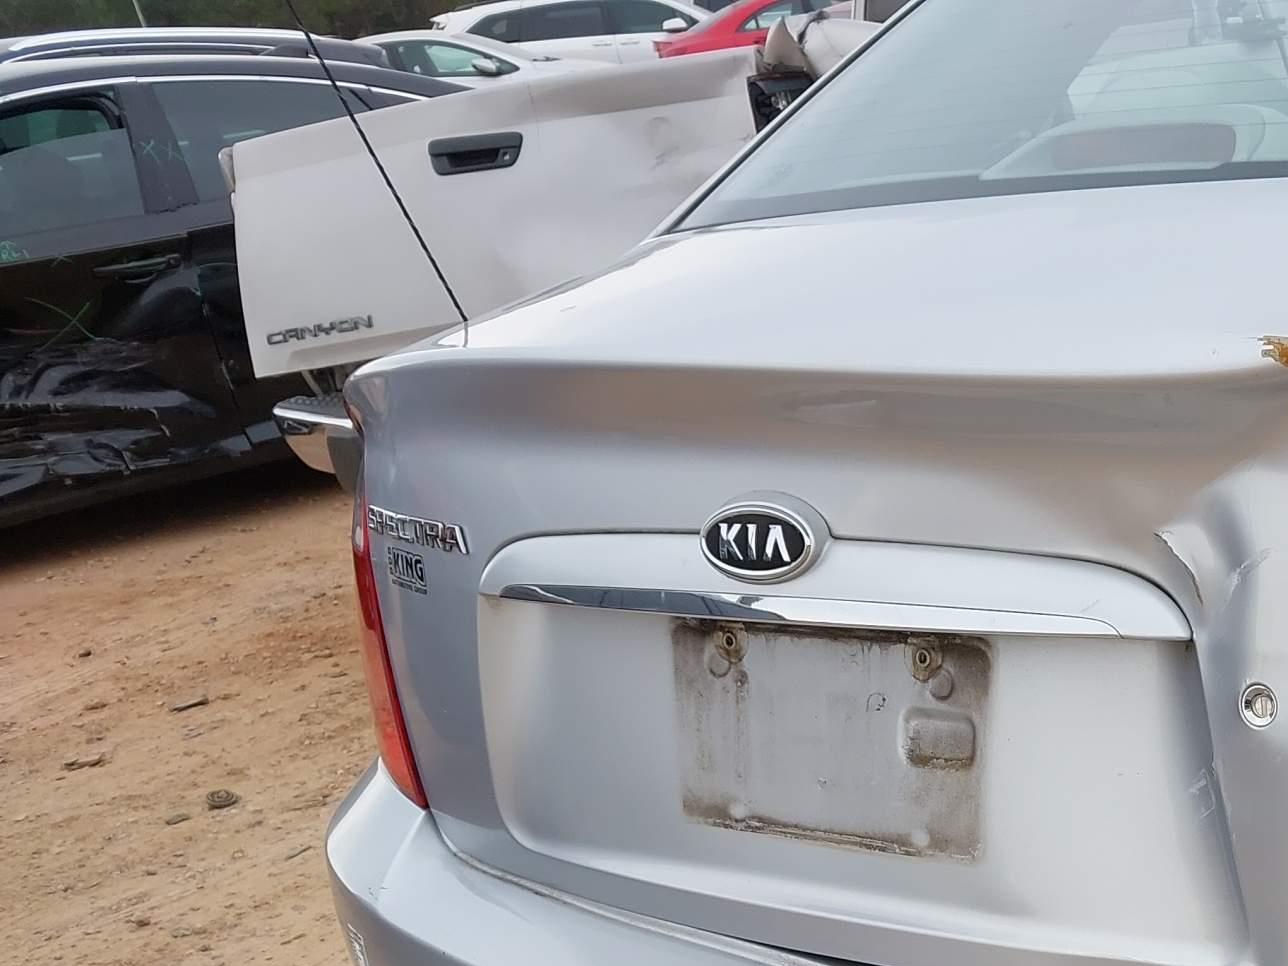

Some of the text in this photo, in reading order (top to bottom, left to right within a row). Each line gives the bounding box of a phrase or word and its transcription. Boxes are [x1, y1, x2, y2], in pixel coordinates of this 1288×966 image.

[266, 315, 374, 346] CANYON
[717, 522, 792, 563] KIA
[392, 549, 426, 584] KING
